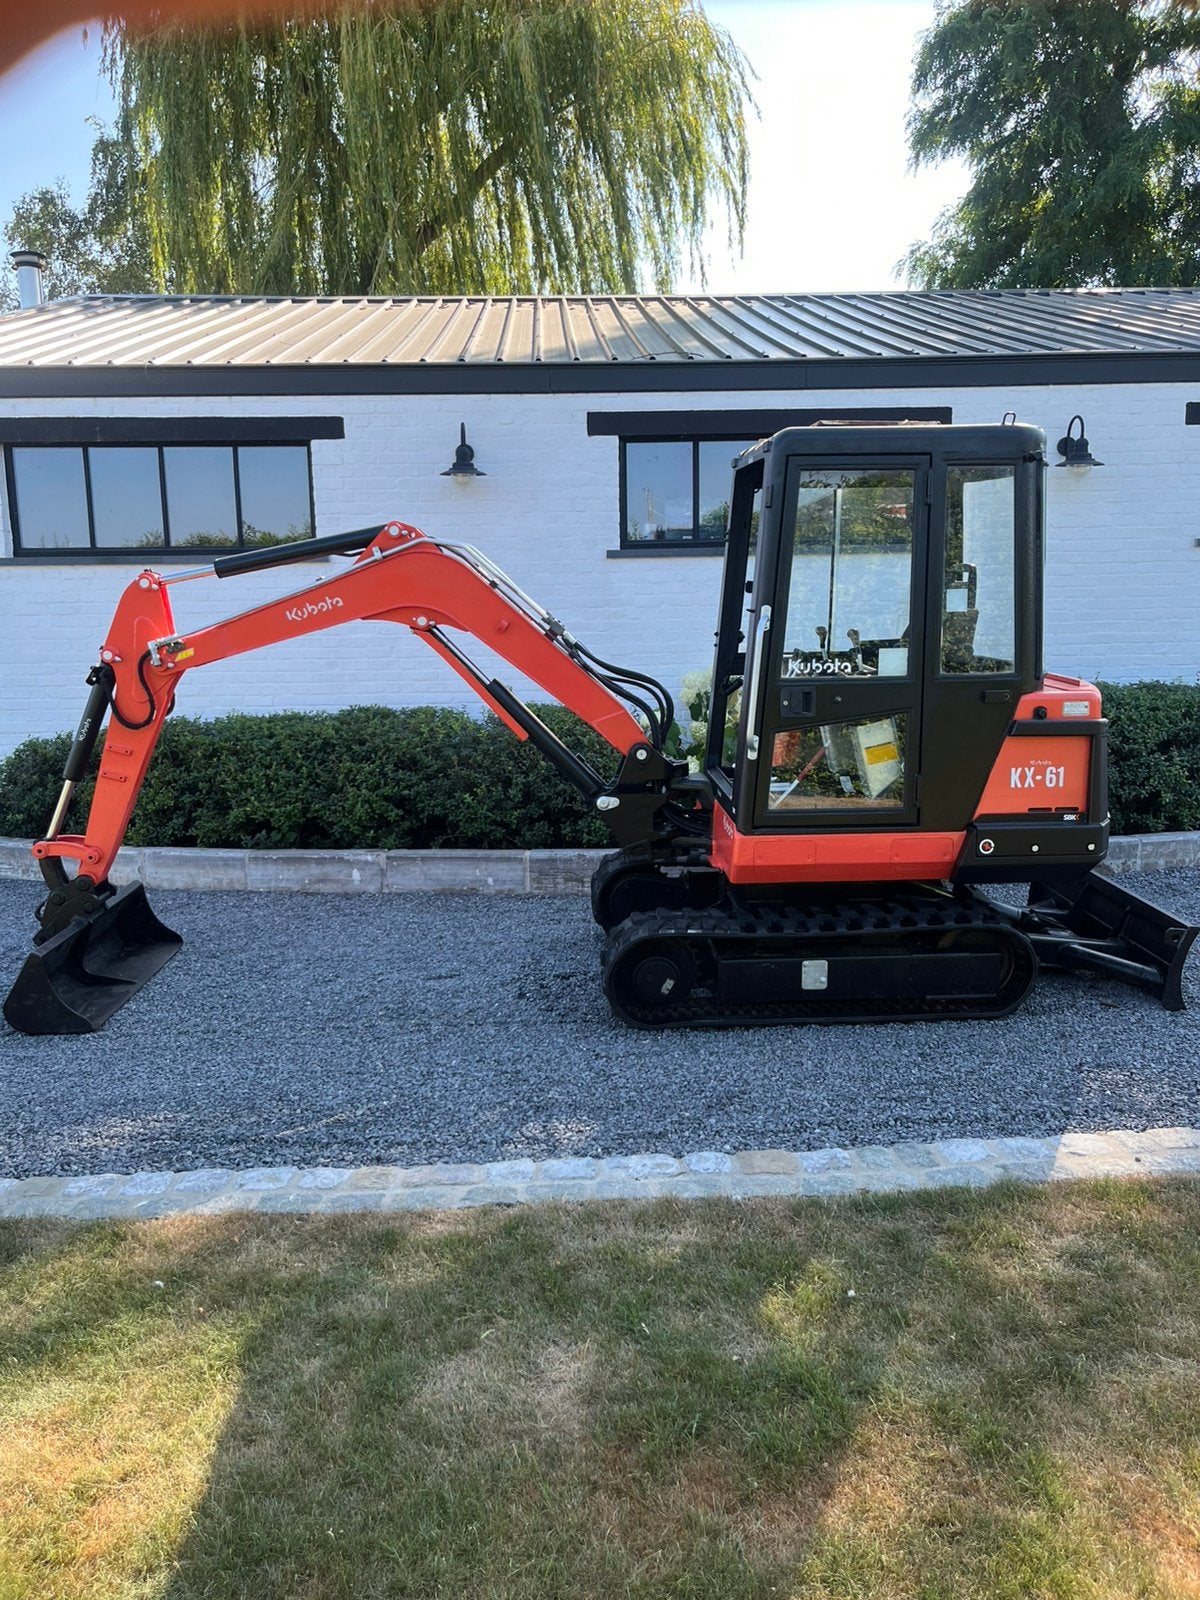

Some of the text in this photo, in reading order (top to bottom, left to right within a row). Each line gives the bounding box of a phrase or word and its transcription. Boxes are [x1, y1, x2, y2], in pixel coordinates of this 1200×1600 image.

[286, 596, 344, 621] Kubota
[788, 658, 852, 674] Kubota
[1010, 766, 1065, 788] KX-61
